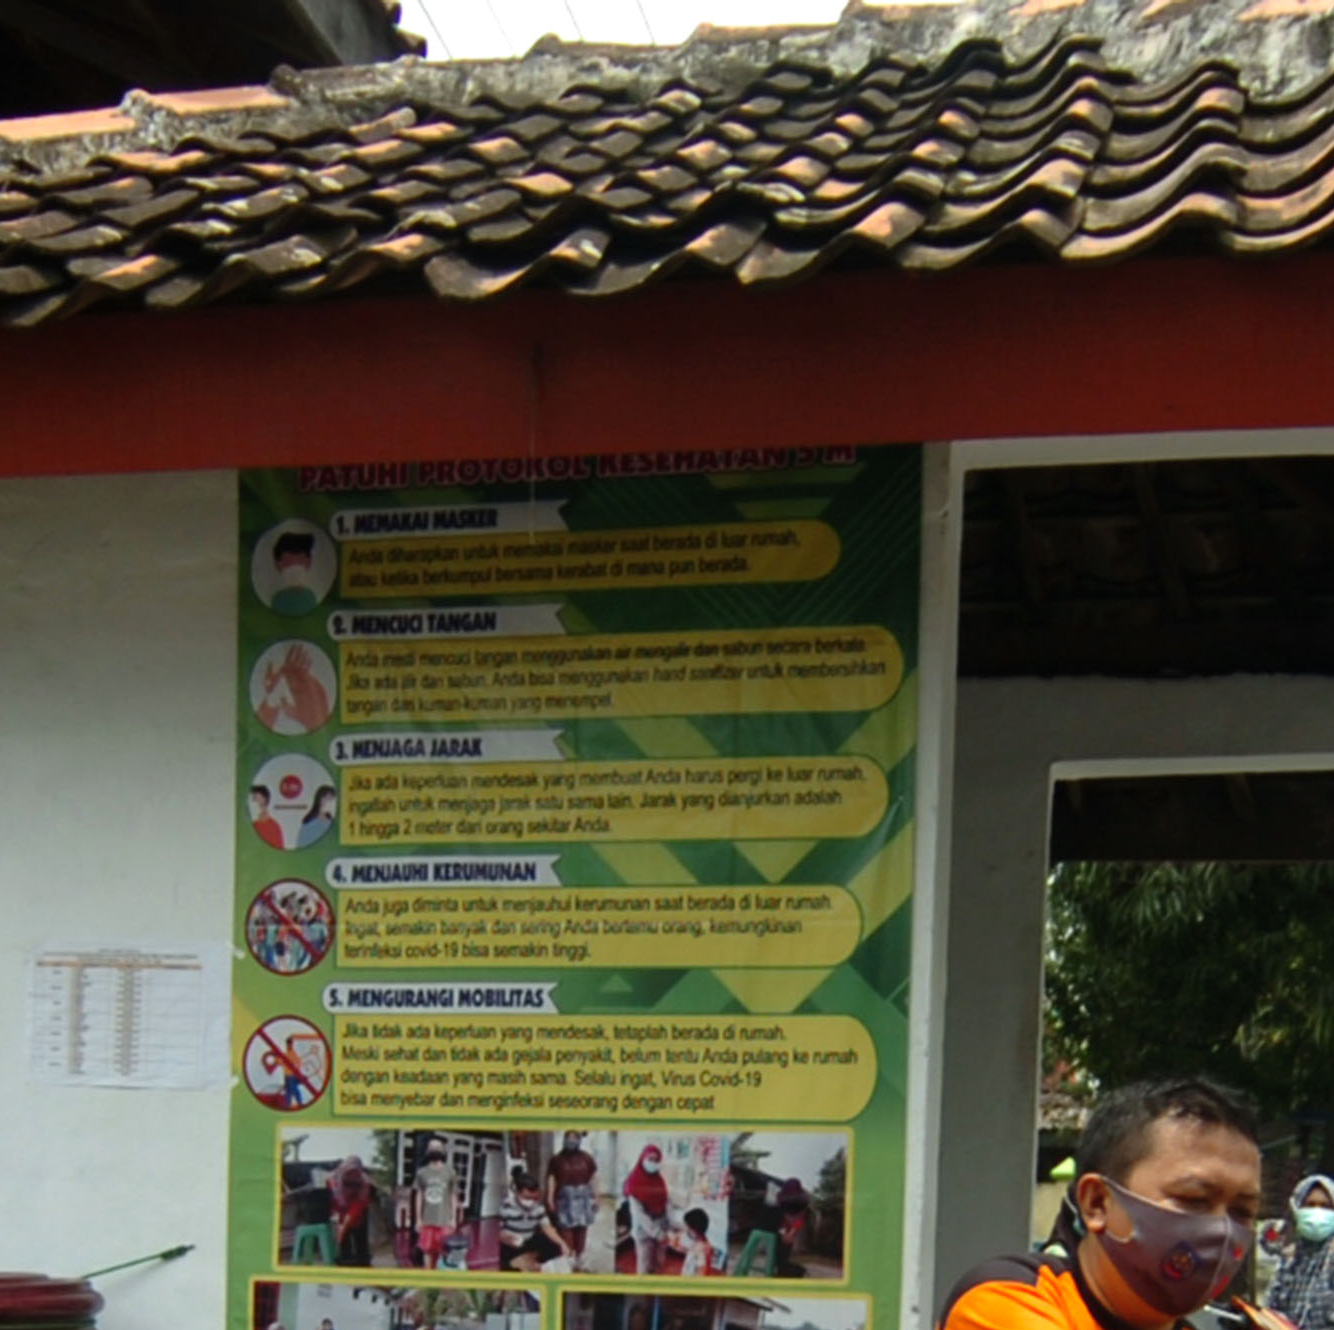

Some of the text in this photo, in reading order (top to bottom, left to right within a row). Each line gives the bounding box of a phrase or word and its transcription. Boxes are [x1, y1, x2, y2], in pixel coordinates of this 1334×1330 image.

[300, 463, 409, 488] PATUHI
[418, 456, 588, 486] PROTOKOL
[598, 447, 788, 477] KESEHATAN
[336, 509, 497, 535] 1. MEMAKAI MASKER
[333, 612, 497, 635] 2. MENCUCI TANGAN
[336, 738, 483, 761] 3. MENJAGA JARAK
[332, 862, 537, 883] 4. MENJAUHI KERUMUNAN
[345, 895, 831, 916] Anda juga diminta untuk menjauhui kerumunan saat berada di luar rumah
[344, 942, 402, 957] terinfeksi
[405, 942, 459, 957] covid-19
[461, 942, 489, 957] bisa
[493, 942, 549, 957] semakin
[329, 988, 544, 1008] 5. MENGURANGI MOBILITAS
[342, 1023, 369, 1038] Jika
[372, 1024, 402, 1038] tidak
[406, 1024, 431, 1038] ada
[433, 1024, 497, 1042] keperluan
[500, 1028, 533, 1043] yang
[613, 1025, 668, 1043] tetaplah
[671, 1025, 719, 1040] berada
[722, 1026, 735, 1040] di
[341, 1046, 379, 1061] Meski
[383, 1046, 419, 1061] sehat
[422, 1046, 447, 1061] dan
[450, 1047, 480, 1061] tidak
[483, 1047, 509, 1061] ada
[511, 1047, 552, 1065] gejala
[619, 1048, 661, 1063] belum
[665, 1048, 699, 1063] tentu
[702, 1048, 738, 1063] Anda
[741, 1049, 789, 1067] pulang
[792, 1049, 809, 1064] ke
[812, 1049, 858, 1064] rumah
[340, 1068, 390, 1086] dengan
[393, 1068, 449, 1084] keadaan
[453, 1073, 483, 1087] yang
[486, 1070, 527, 1084] masih
[574, 1070, 616, 1085] Selalu
[661, 1071, 696, 1086] Virus
[699, 1072, 762, 1087] Covid-19
[340, 1091, 715, 1113] bisa menyebar dan menginfeksi seseorang dengan cepat
